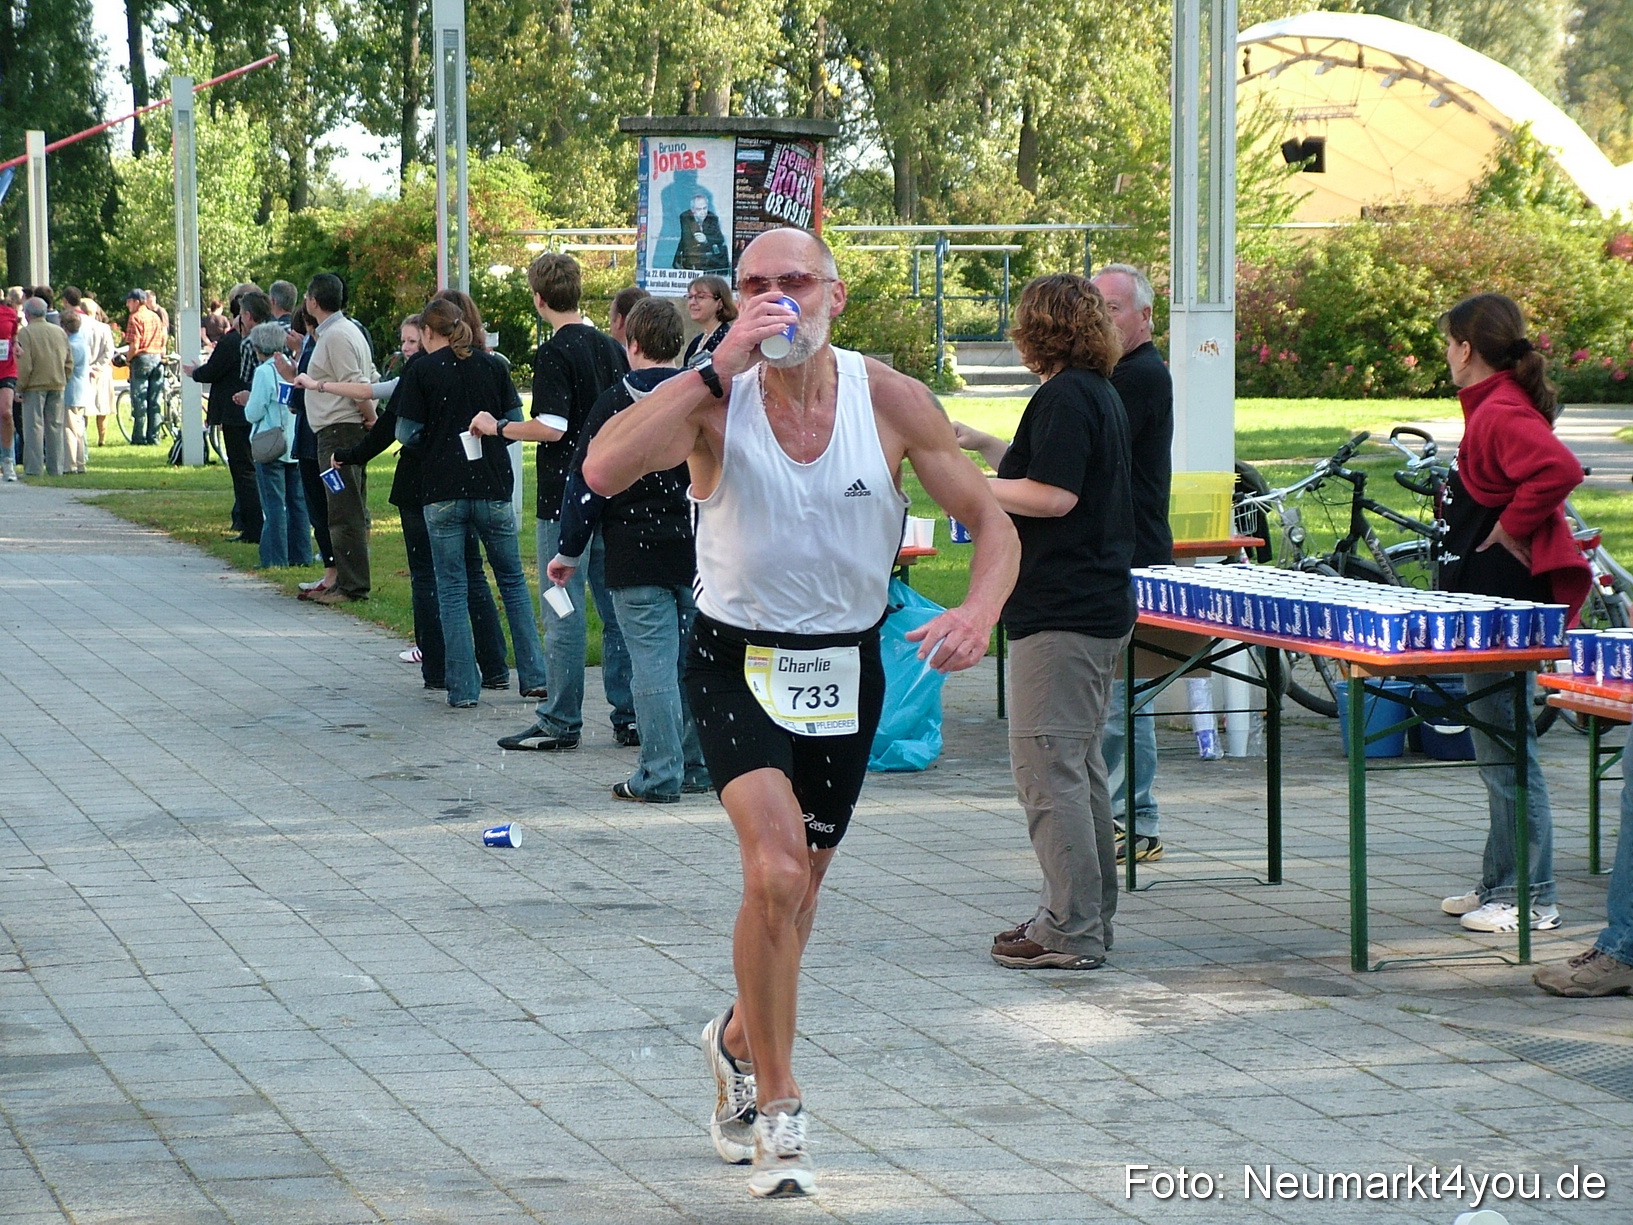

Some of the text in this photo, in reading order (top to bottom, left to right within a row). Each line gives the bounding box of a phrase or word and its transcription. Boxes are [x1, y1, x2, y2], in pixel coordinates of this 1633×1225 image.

[659, 142, 687, 154] Bruno
[652, 150, 707, 181] Jonas
[770, 165, 815, 209] ROCK
[765, 191, 812, 230] 08.09.07
[678, 271, 687, 279] 20
[844, 489, 871, 497] adidas
[778, 657, 831, 673] Charlie
[788, 684, 840, 710] 733
[816, 719, 856, 730] PFLEIDERER
[808, 820, 836, 833] asics
